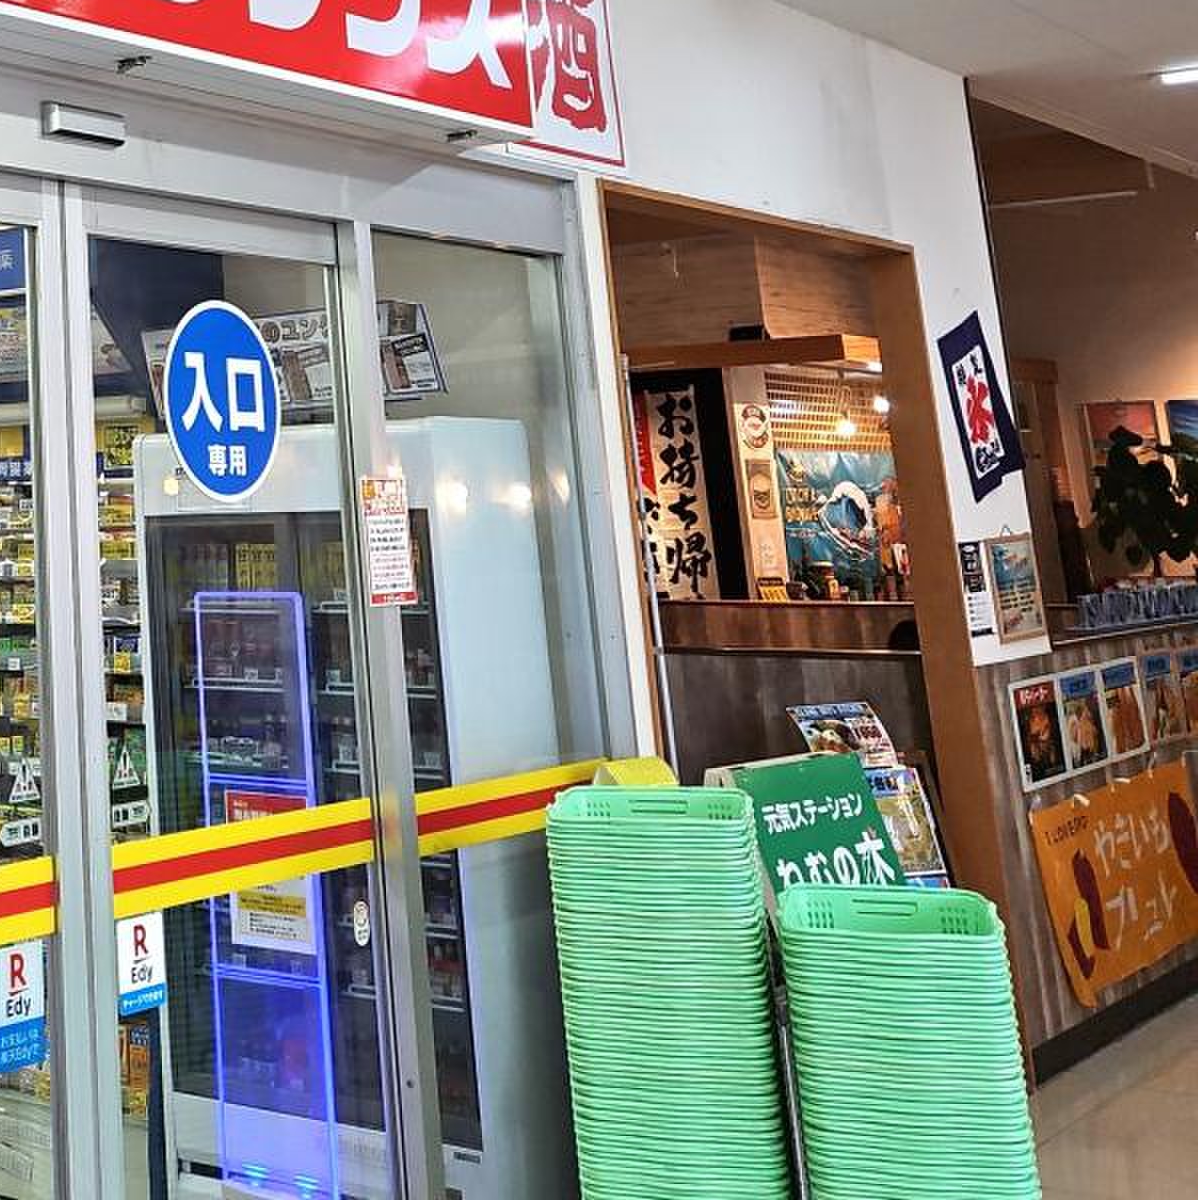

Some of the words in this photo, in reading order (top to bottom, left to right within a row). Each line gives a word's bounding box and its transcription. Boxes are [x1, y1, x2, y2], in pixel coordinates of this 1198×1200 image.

[181, 351, 266, 433] 入口
[207, 444, 247, 477] 専用
[658, 392, 713, 600] お持ち帰
[761, 793, 863, 835] 元気ステーション
[133, 924, 148, 957] R
[9, 953, 27, 988] R
[130, 965, 153, 985] Edy
[5, 996, 32, 1018] Edy
